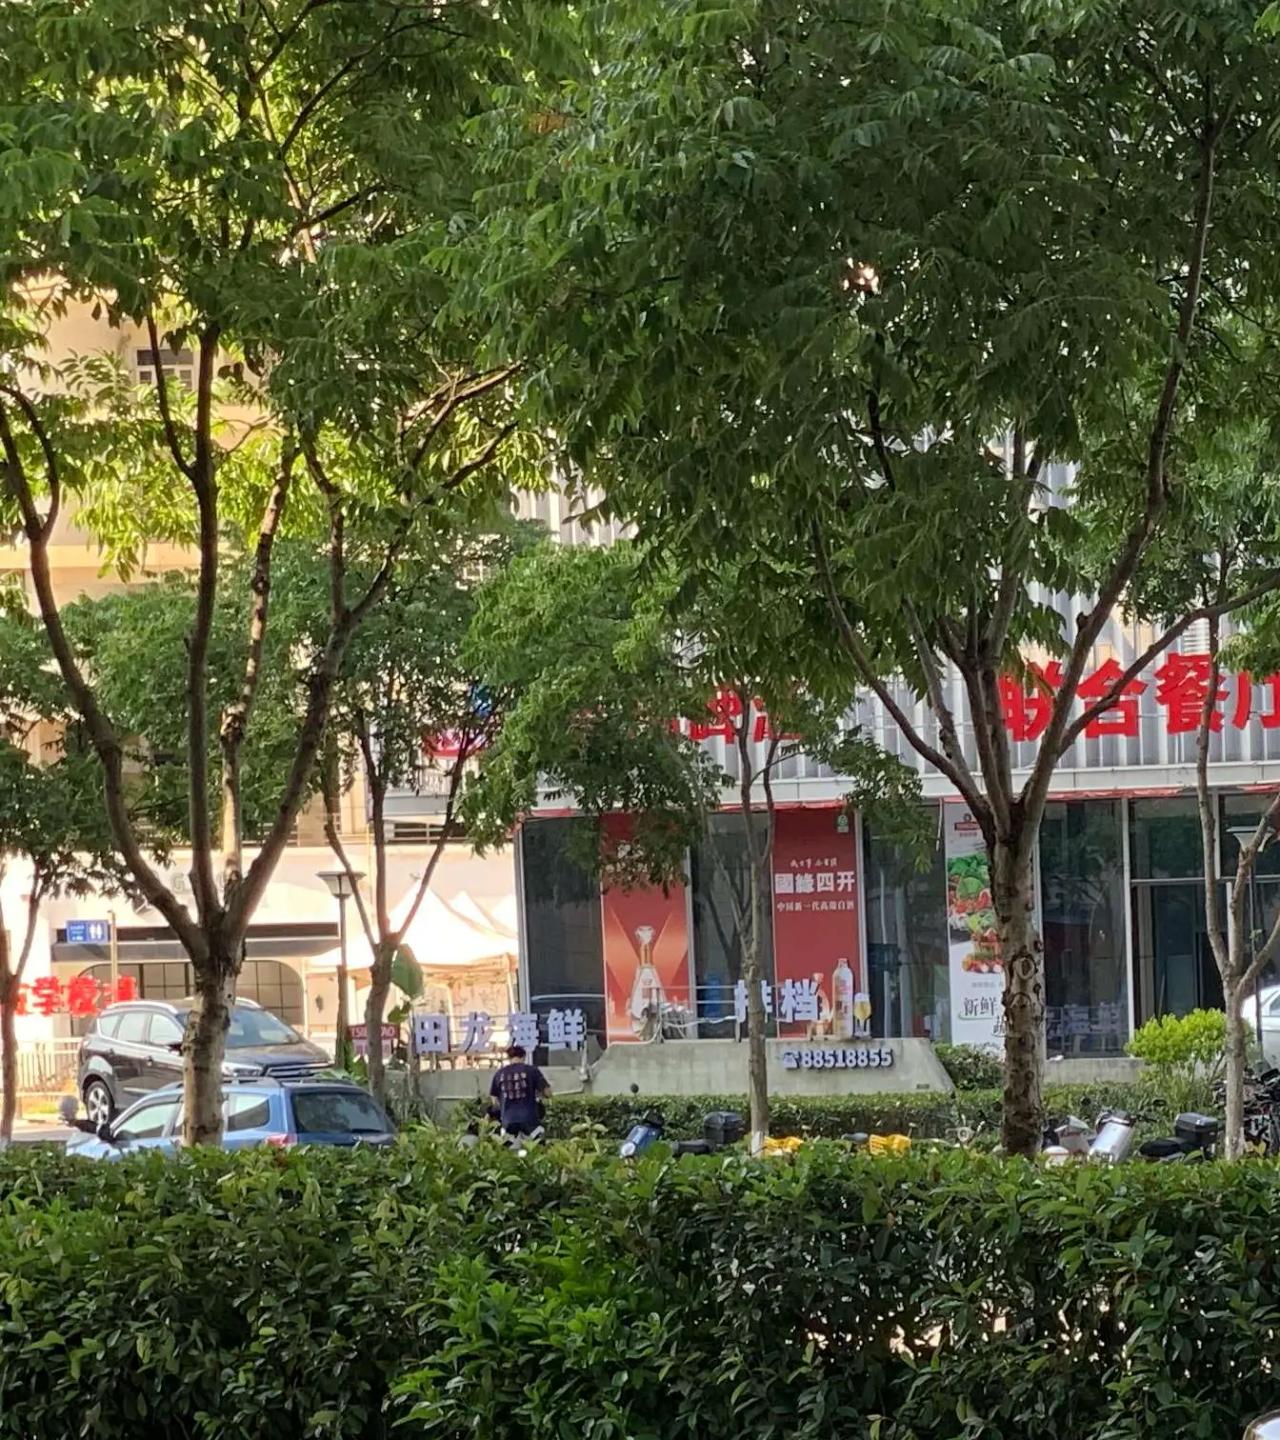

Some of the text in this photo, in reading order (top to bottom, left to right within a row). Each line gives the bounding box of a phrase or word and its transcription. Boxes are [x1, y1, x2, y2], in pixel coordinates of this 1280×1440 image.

[415, 1008, 586, 1053] 田龙海鲜
[801, 1049, 893, 1068] 88518855
